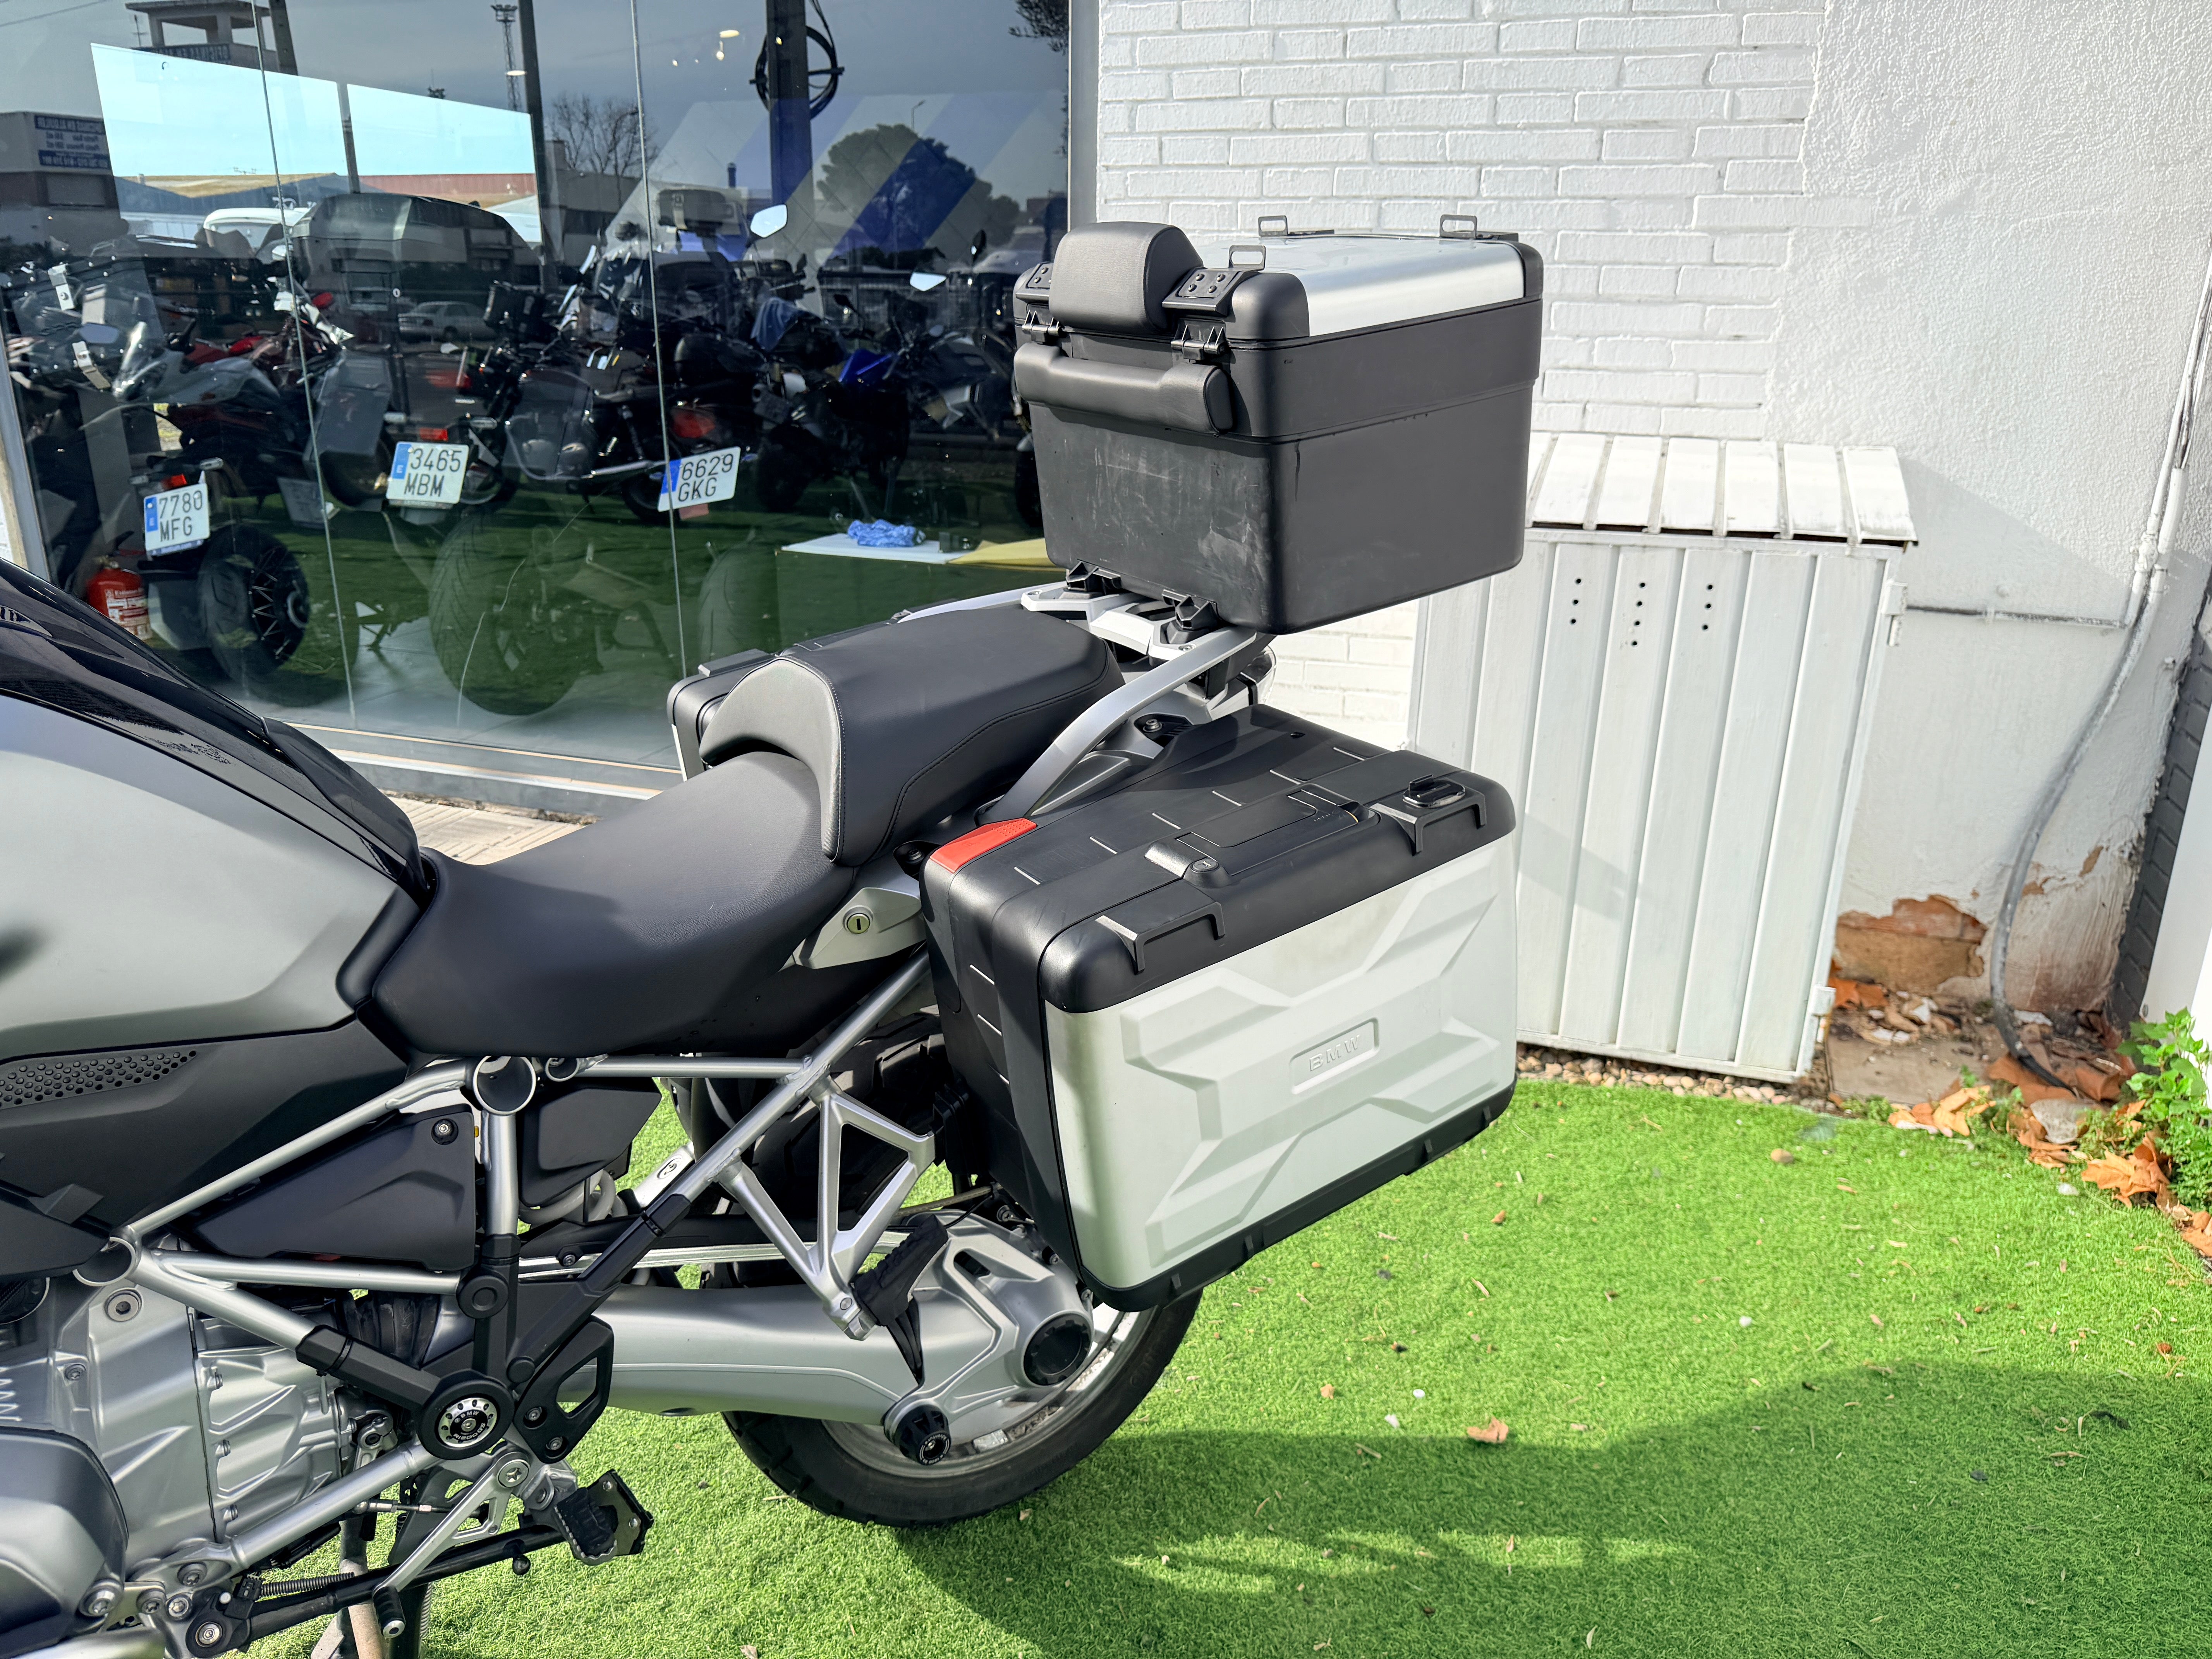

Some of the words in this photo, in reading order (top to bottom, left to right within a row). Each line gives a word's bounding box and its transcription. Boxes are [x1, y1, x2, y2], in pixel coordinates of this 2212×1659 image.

[397, 465, 404, 473] E
[410, 448, 462, 472] 3465
[682, 453, 733, 481] 6629
[404, 473, 445, 497] MBM
[678, 477, 717, 502] GKG
[159, 490, 203, 519] 7780
[160, 516, 192, 542] MFG
[1309, 1034, 1360, 1072] BMW
